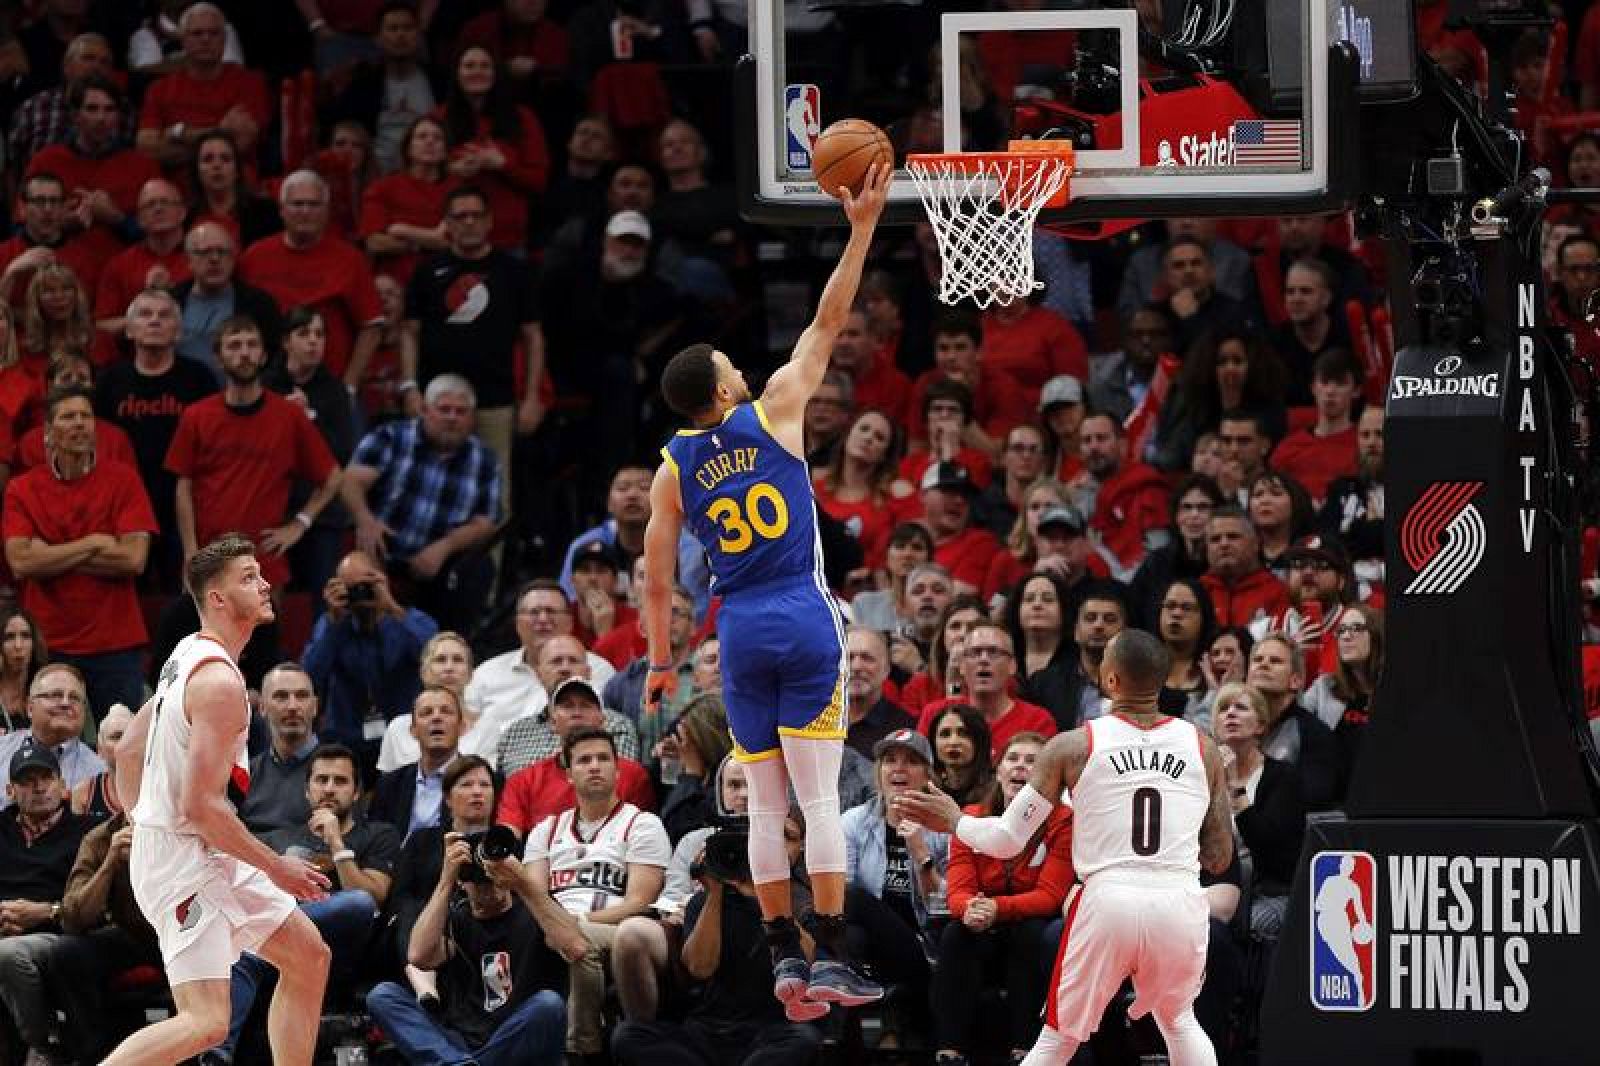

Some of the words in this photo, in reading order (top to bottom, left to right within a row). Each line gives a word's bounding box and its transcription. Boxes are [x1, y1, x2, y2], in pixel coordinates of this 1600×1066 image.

[1391, 373, 1499, 399] SPALDING
[1518, 284, 1536, 431] NBA
[695, 447, 758, 490] CURRY
[706, 483, 788, 553] 30
[1519, 457, 1536, 552] TV
[1109, 749, 1186, 779] LILLARD
[1132, 787, 1162, 856] 0
[1388, 855, 1580, 934] WESTERN
[1320, 975, 1350, 1000] NBA
[1390, 934, 1529, 1012] FINALS
